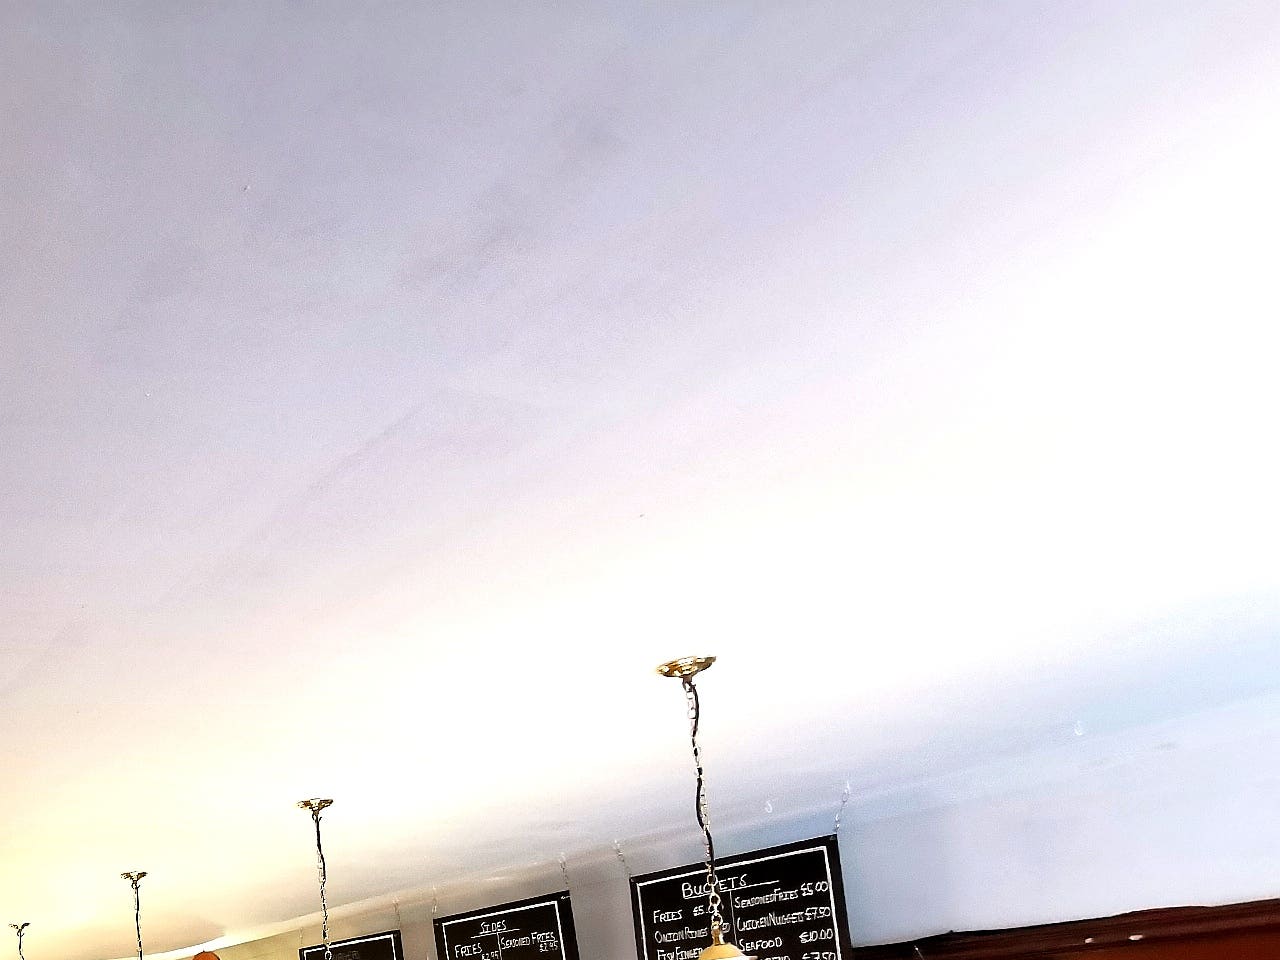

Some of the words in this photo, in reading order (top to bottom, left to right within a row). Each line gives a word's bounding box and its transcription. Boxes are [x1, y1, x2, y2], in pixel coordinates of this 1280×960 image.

[682, 874, 748, 897] BUCETS
[479, 919, 507, 934] SIDES
[454, 942, 483, 958] FRIES
[739, 937, 783, 952] SEAFOOD
